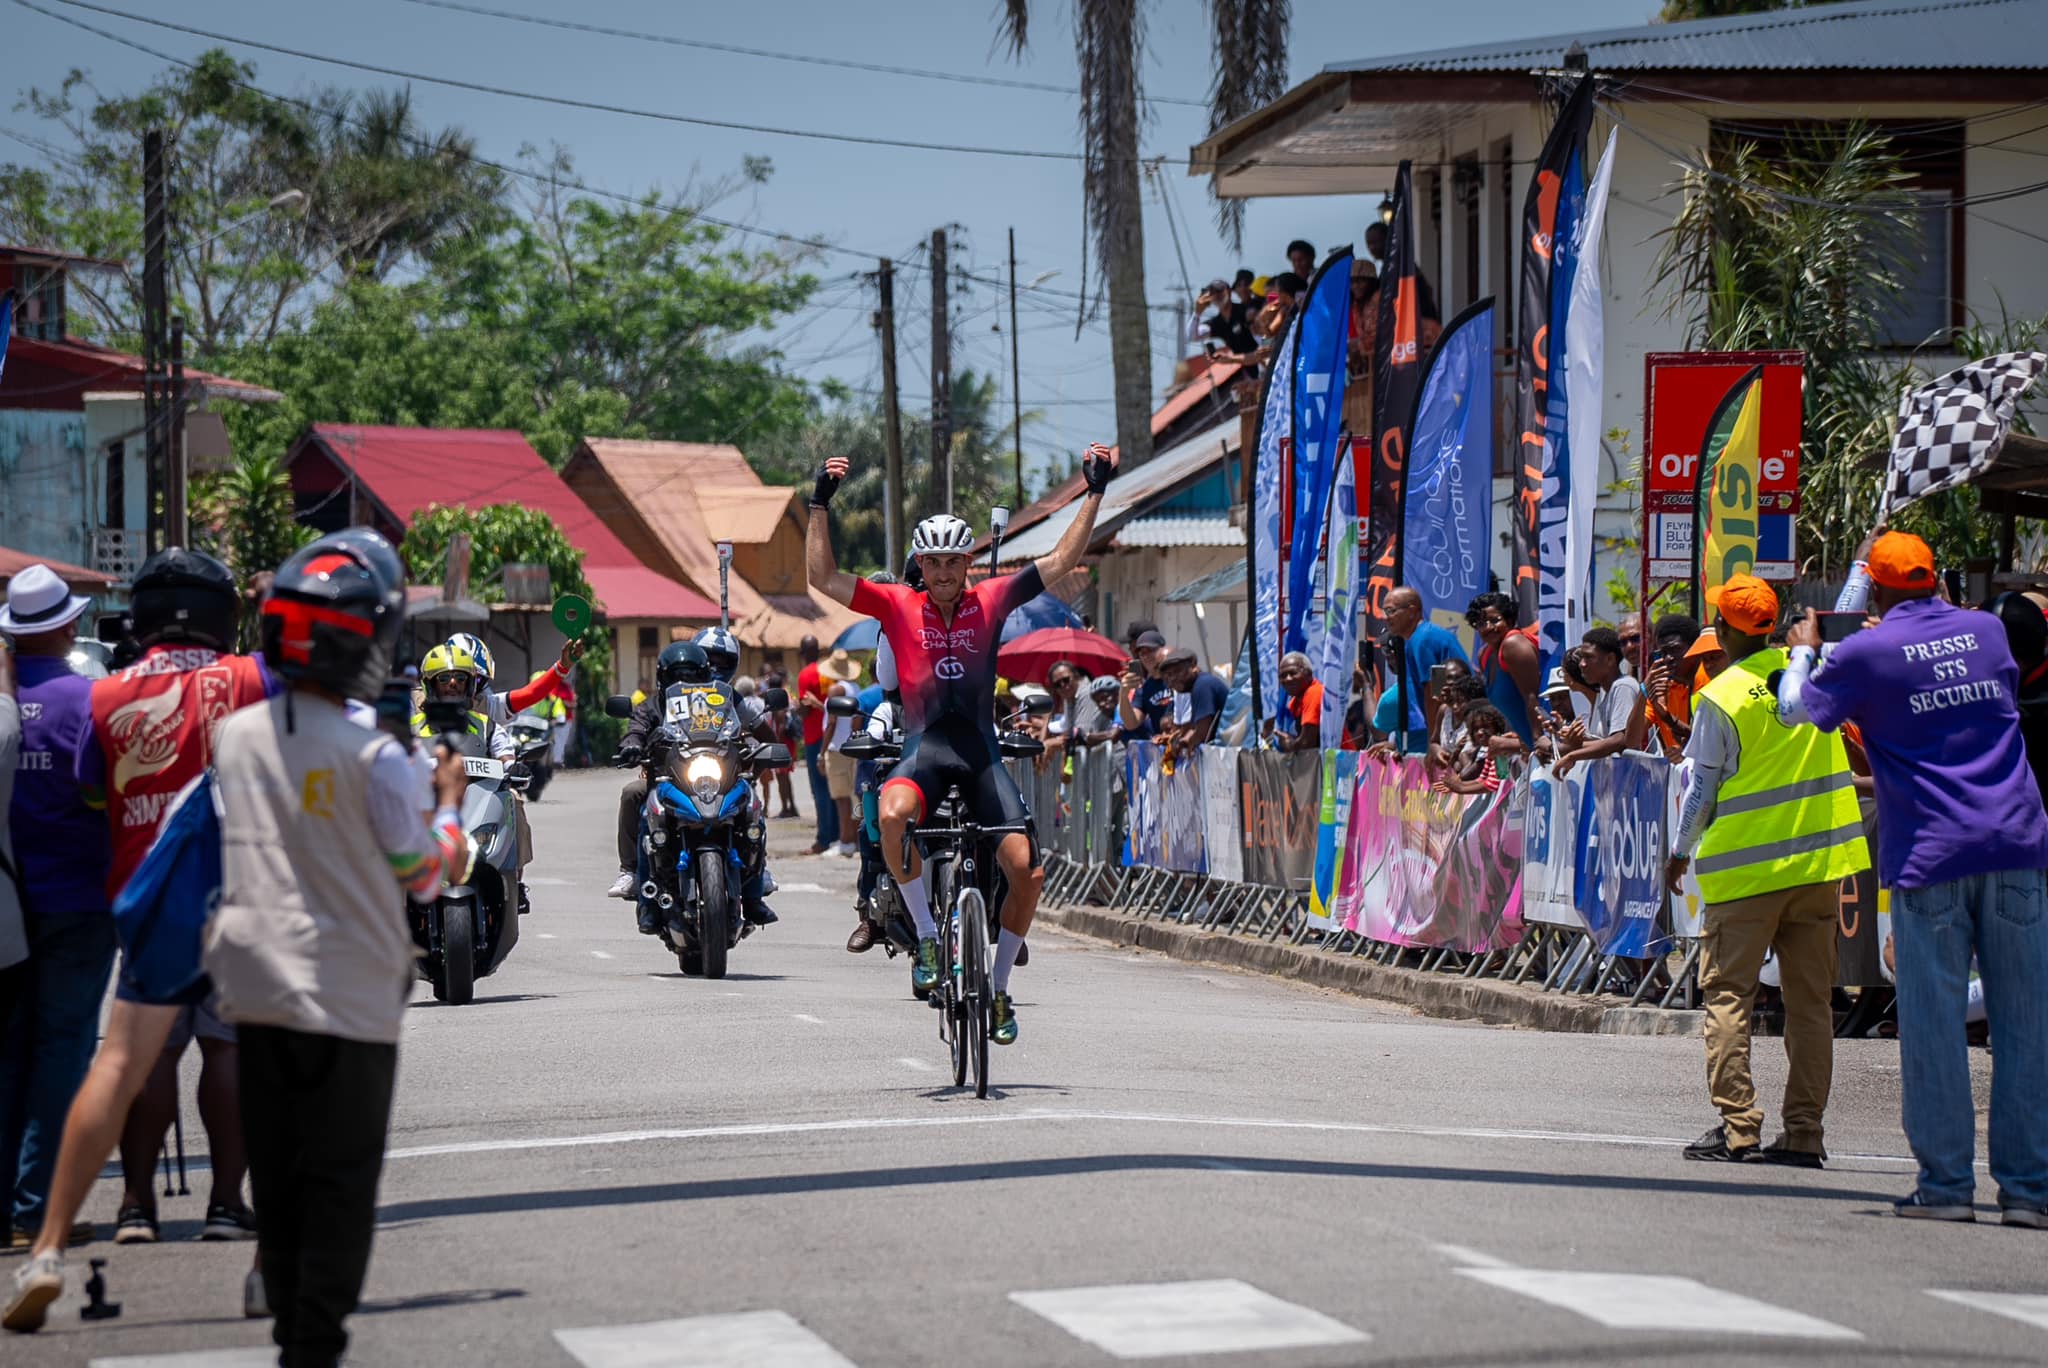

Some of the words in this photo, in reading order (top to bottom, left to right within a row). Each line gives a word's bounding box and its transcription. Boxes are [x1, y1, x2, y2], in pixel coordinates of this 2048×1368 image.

[1659, 452, 1786, 484] ore
[1450, 445, 1478, 589] Formation
[1666, 522, 1693, 530] FLYIN
[1666, 531, 1693, 541] BLU
[917, 627, 975, 641] MAISON
[921, 639, 978, 652] CHAZAL
[1902, 633, 1978, 663] PRESSE
[1932, 658, 1968, 681] STS
[1909, 680, 2002, 714] SECURITE
[674, 700, 686, 716] 1
[465, 760, 490, 773] ITRE
